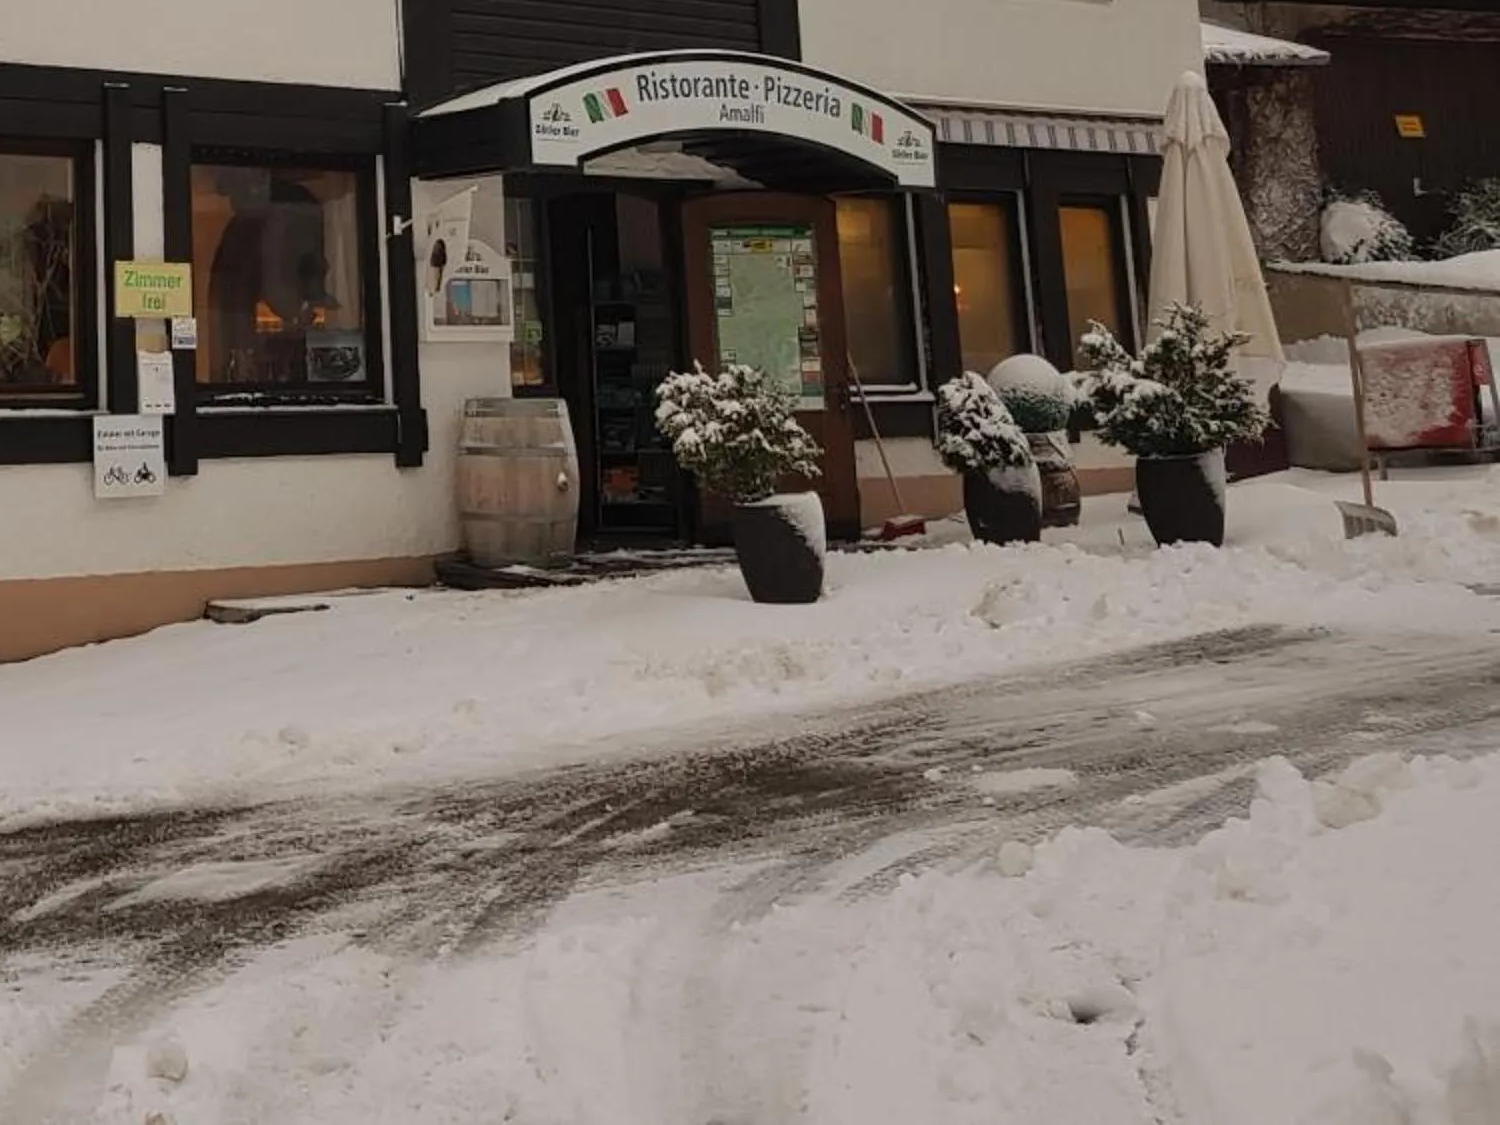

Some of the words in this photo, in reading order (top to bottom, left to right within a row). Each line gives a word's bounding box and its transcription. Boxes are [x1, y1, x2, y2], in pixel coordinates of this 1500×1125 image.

[636, 71, 750, 102] Ristorante
[763, 76, 842, 118] Pizzeria
[719, 103, 766, 124] Amalfi
[123, 270, 182, 289] Zimmer
[142, 292, 166, 310] frei
